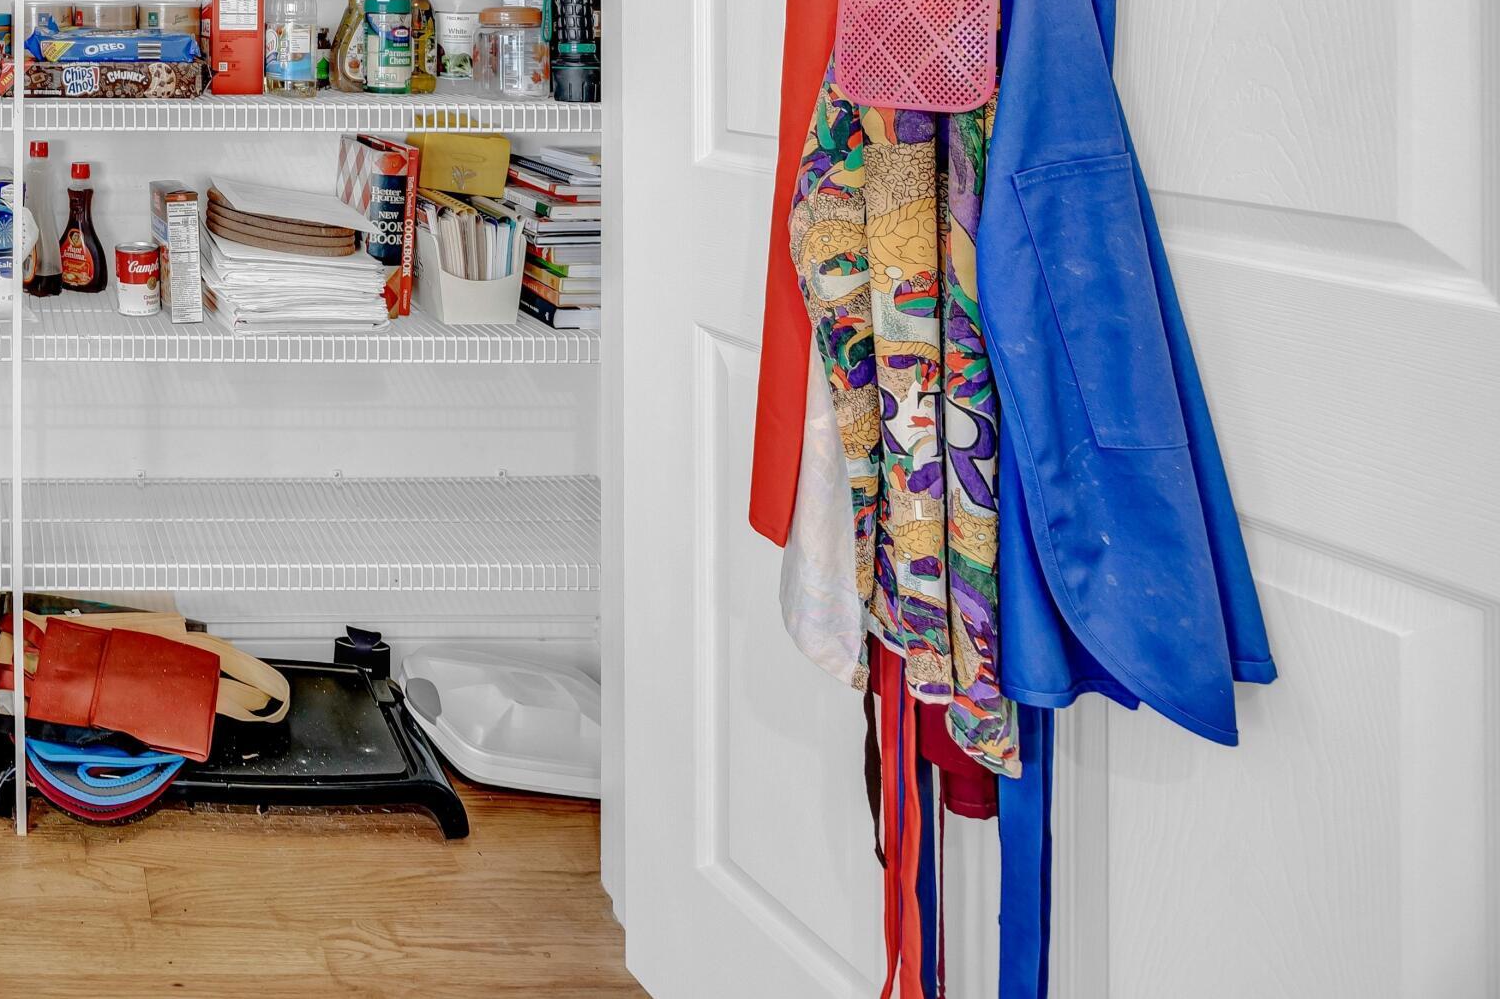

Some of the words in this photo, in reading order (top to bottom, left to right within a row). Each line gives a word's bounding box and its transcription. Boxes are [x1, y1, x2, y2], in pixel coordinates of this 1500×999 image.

[448, 27, 468, 35] White
[84, 42, 125, 56] OREO
[64, 66, 94, 81] Chips
[106, 69, 146, 83] CHUNKY
[68, 70, 99, 93] Ahoy!
[407, 176, 415, 190] Betty
[371, 185, 402, 196] Better
[371, 192, 405, 204] Homes
[378, 210, 399, 220] NEW
[371, 219, 404, 233] COOK
[369, 232, 403, 246] BOOK
[402, 219, 414, 279] COOKBOOK
